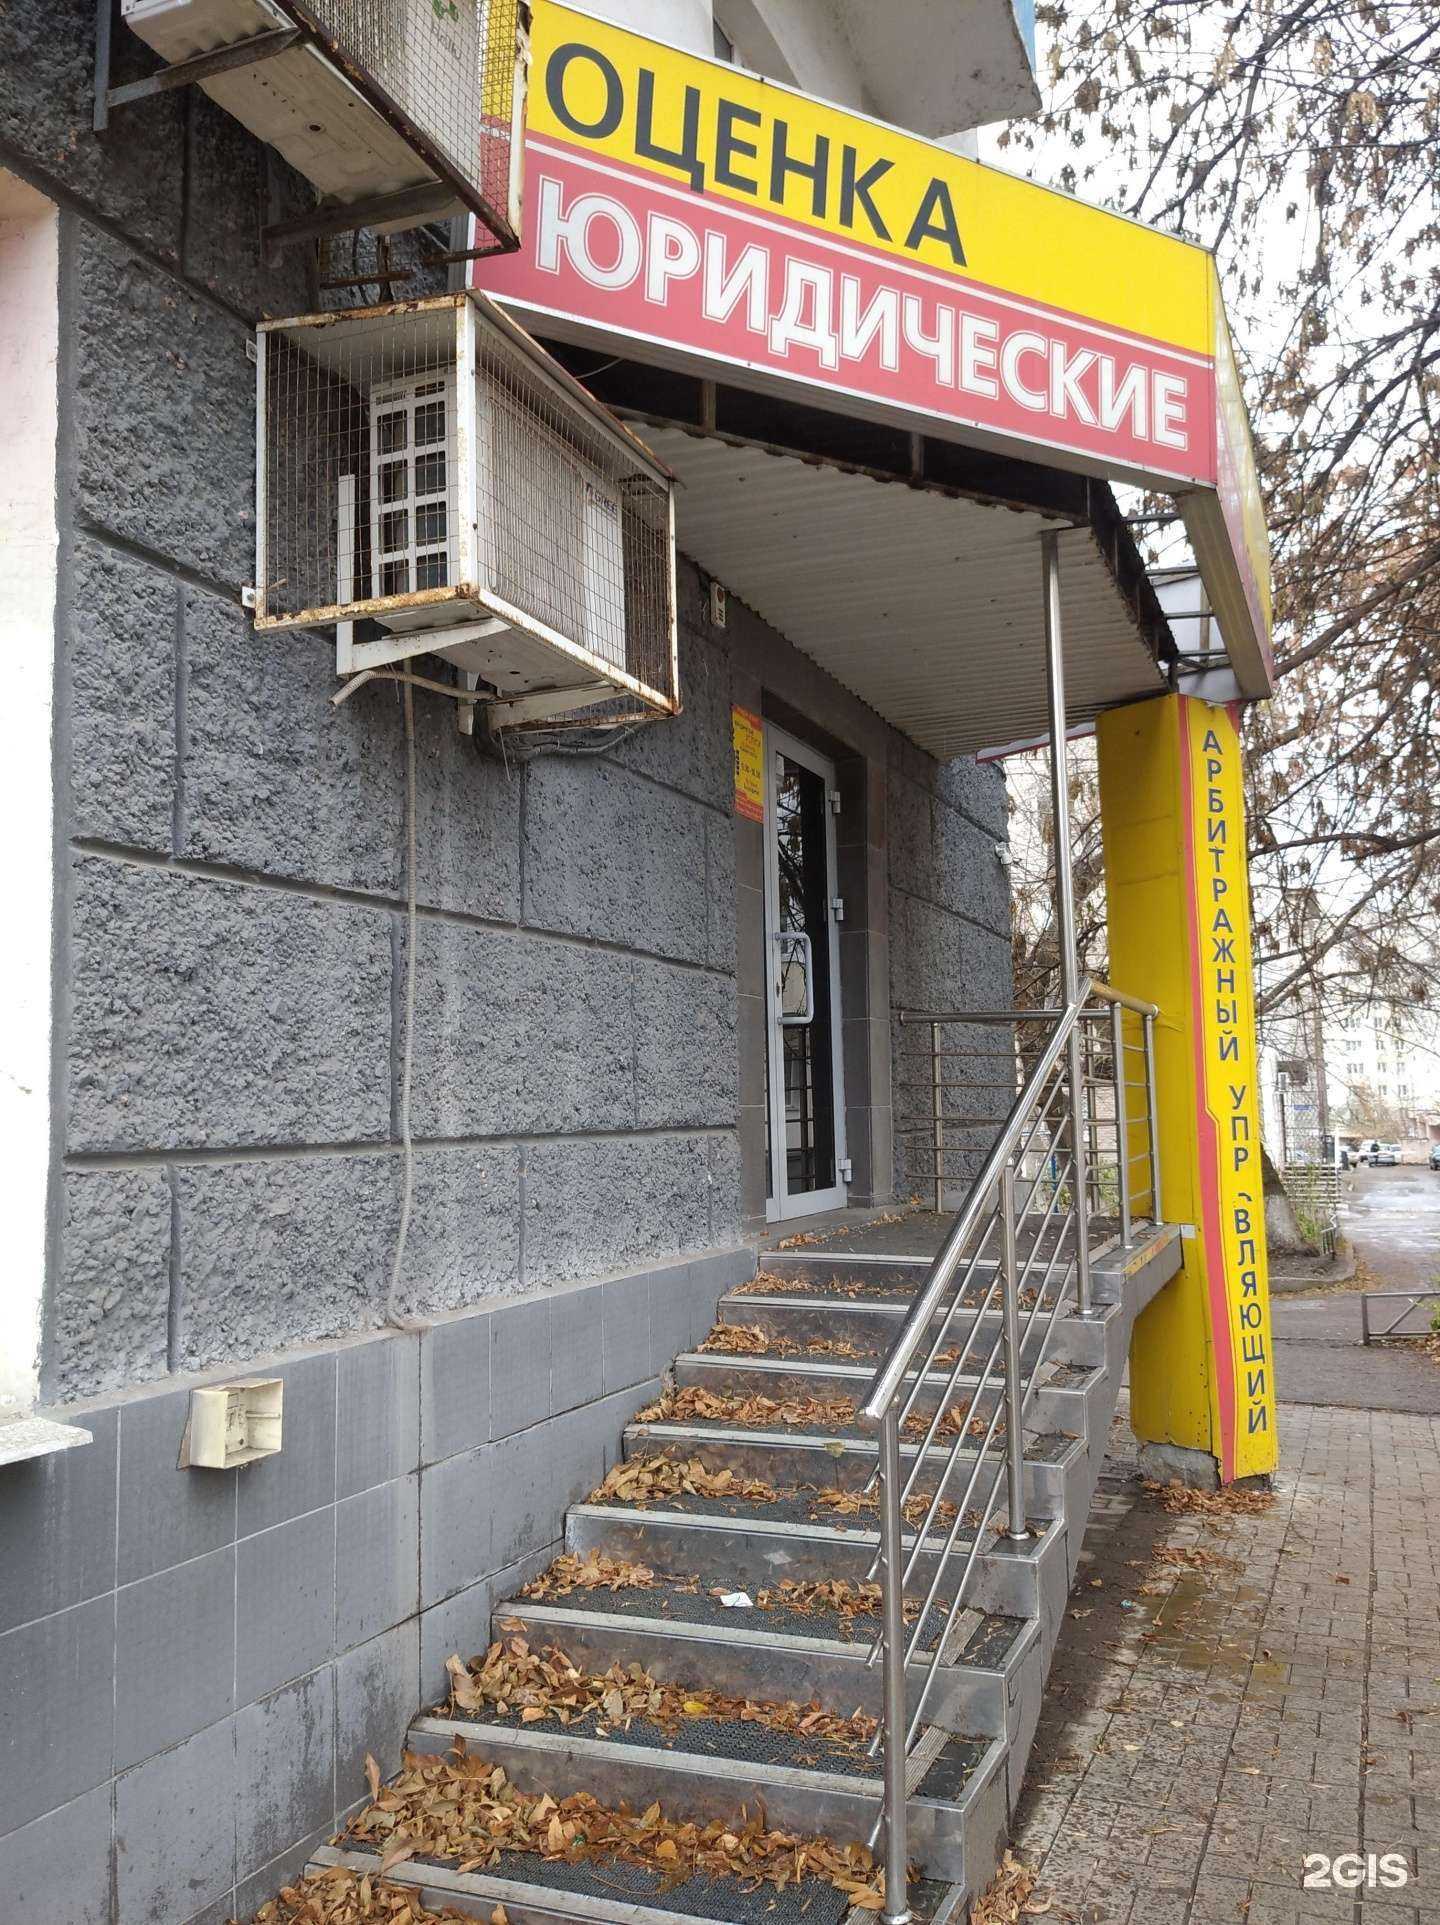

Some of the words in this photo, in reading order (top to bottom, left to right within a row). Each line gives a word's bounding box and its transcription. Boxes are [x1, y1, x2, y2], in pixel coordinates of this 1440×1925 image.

[546, 43, 968, 267] ОЦЕНКА
[535, 174, 1189, 451] ЮРИДИЧЕСКИЕ
[1202, 729, 1239, 1062] АРБИТРАЖНЫЙ
[1230, 1085, 1267, 1434] УПРВЛЯЮЩИЙ
